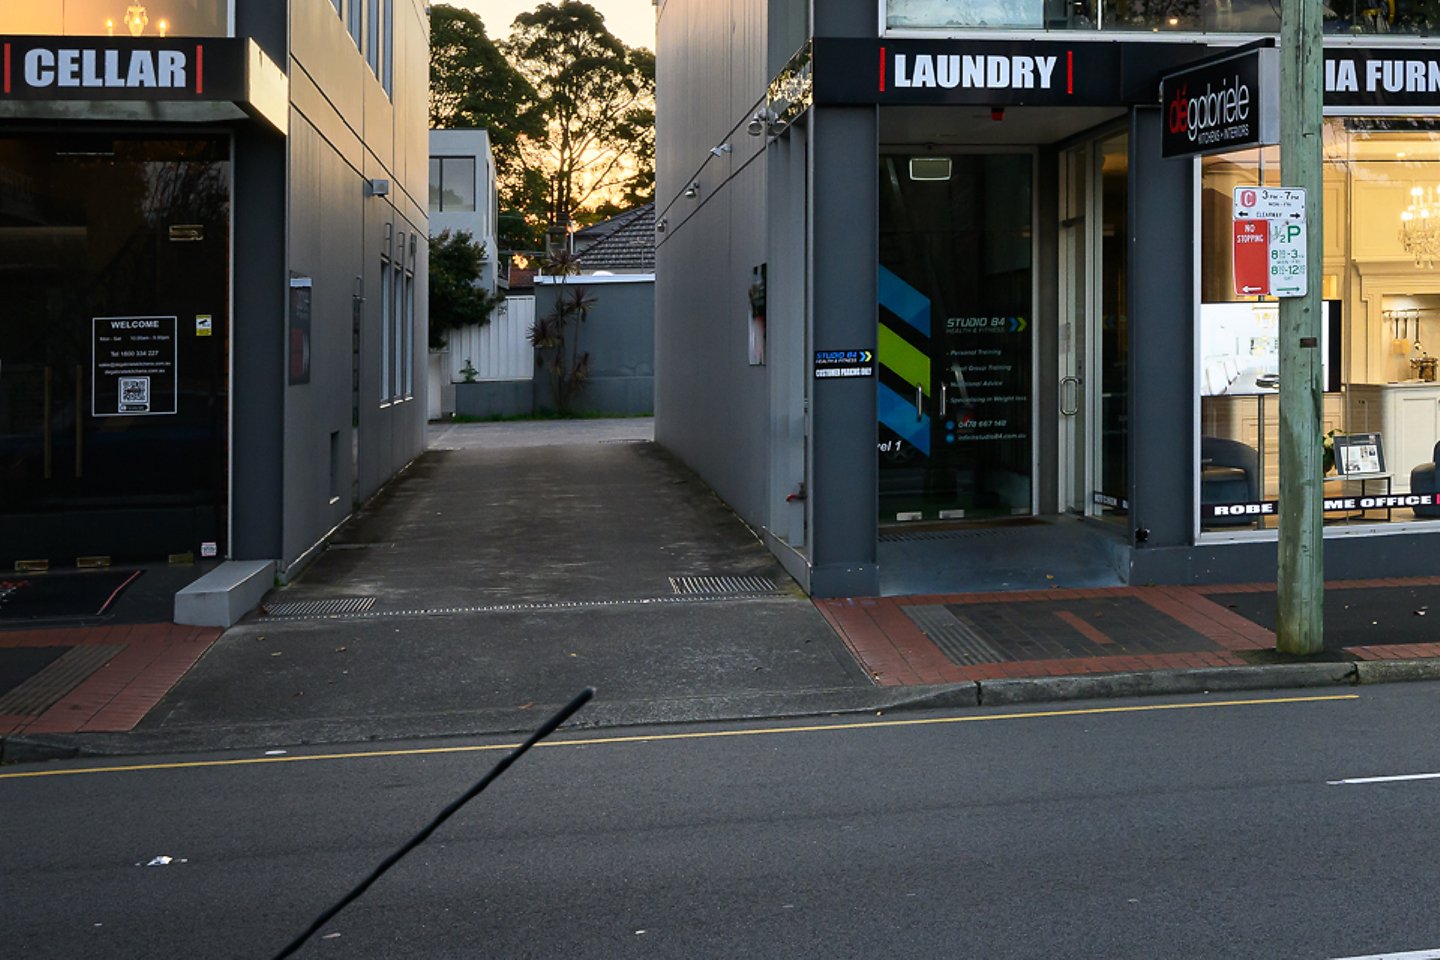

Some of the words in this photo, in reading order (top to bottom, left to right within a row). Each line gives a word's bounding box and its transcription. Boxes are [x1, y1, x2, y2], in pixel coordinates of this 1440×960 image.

[23, 47, 188, 88] CELLAR
[894, 54, 1057, 89] LAUNDRY
[1325, 59, 1359, 92] IA
[1244, 224, 1256, 233] NO
[1236, 234, 1264, 244] STOPPING
[110, 320, 160, 329] WELCOME
[946, 317, 989, 329] STUDIO
[991, 317, 1006, 327] 84
[1213, 503, 1274, 517] ROBE
[1323, 498, 1356, 510] ME
[1360, 495, 1432, 509] OFFICE
